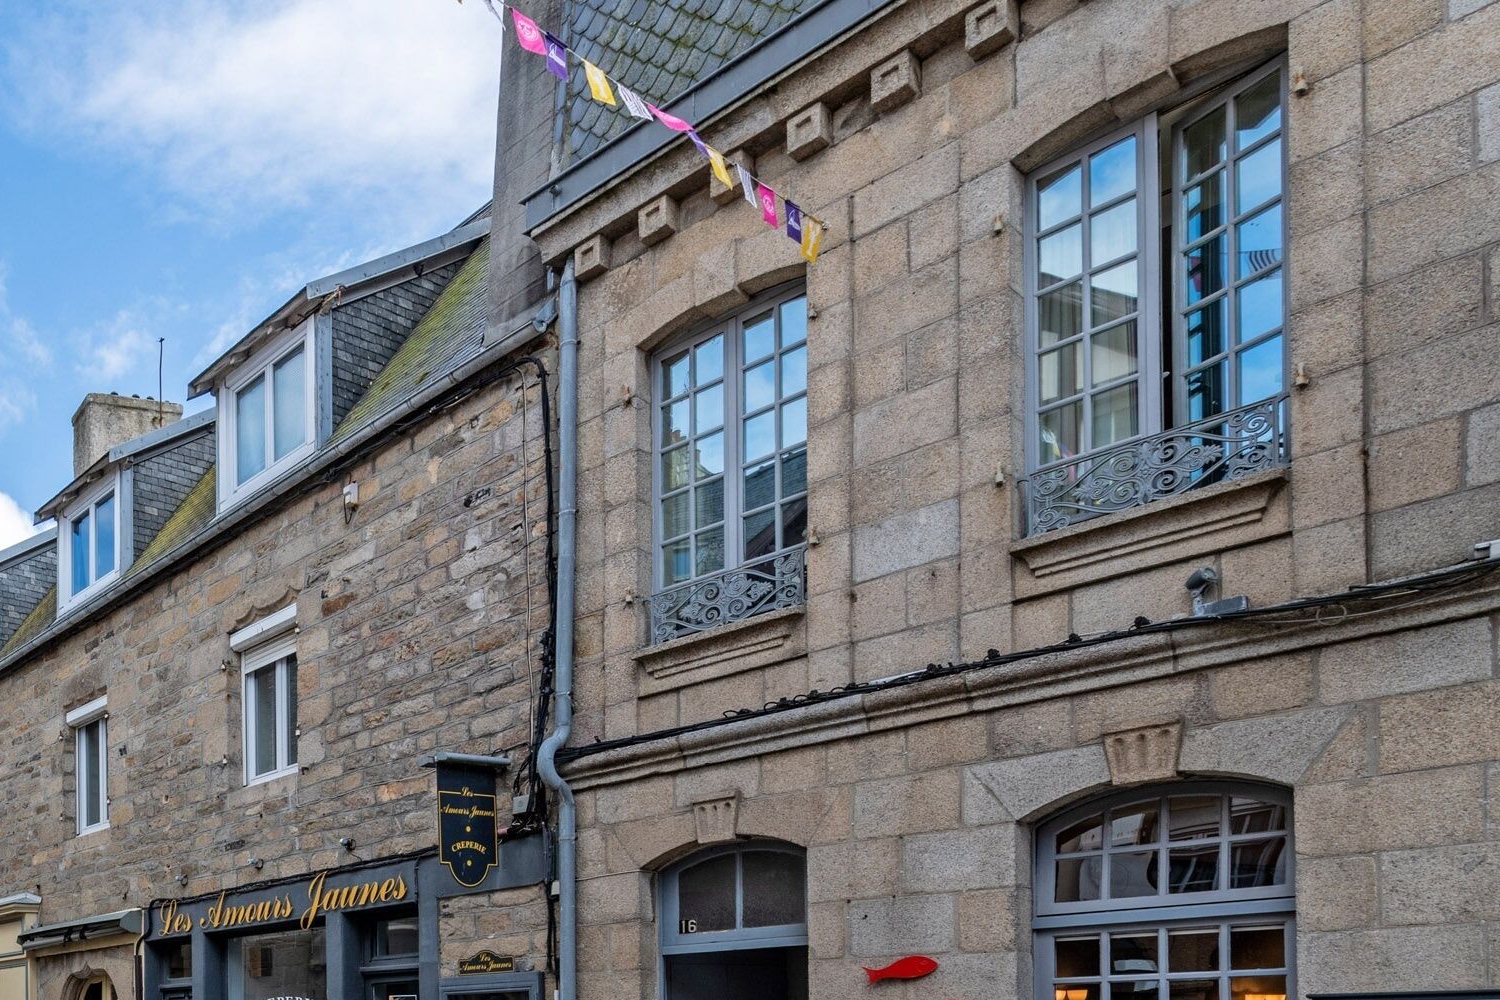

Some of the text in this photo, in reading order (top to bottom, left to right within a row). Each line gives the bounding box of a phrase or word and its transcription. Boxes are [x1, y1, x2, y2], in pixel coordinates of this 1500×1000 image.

[461, 786, 474, 798] Les
[440, 803, 495, 819] Amours Jaunes
[451, 840, 487, 855] CREPERIE
[158, 870, 409, 937] Les Amours Jaunes
[681, 920, 698, 934] 16
